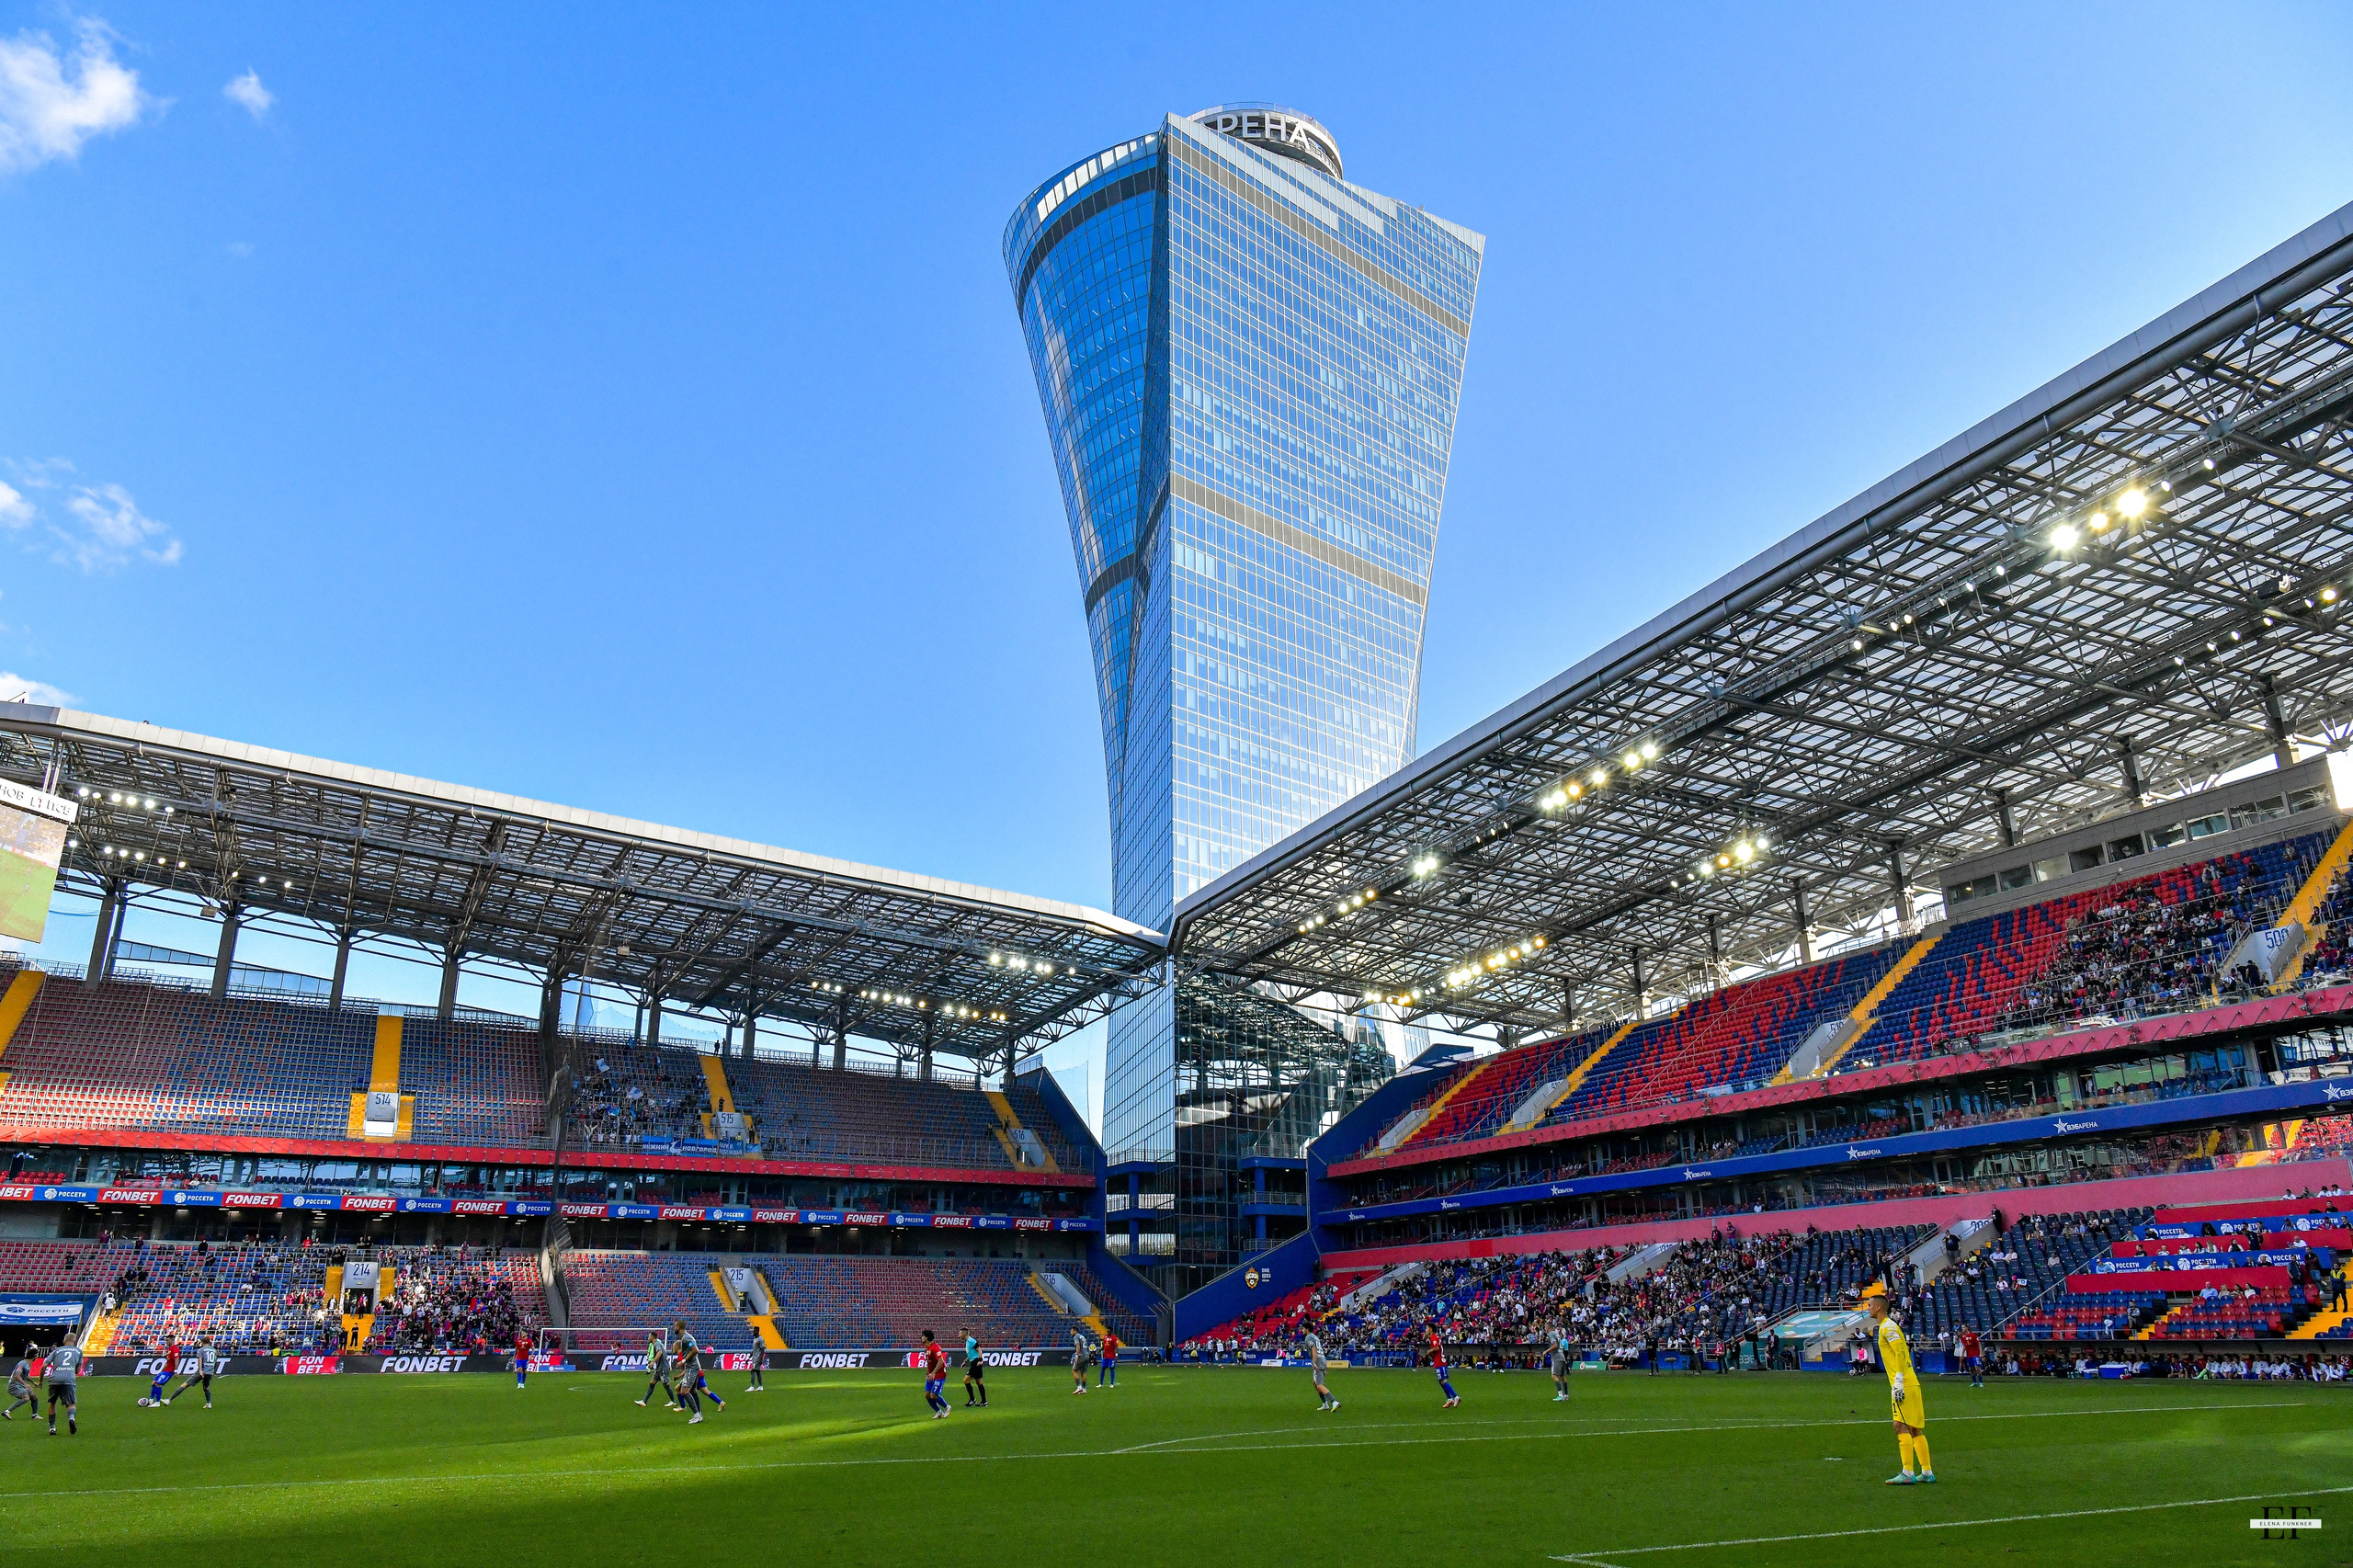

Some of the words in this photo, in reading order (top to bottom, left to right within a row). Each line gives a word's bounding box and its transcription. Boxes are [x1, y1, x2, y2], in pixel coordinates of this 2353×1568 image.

[1200, 112, 1311, 150] РЕНА
[375, 1093, 391, 1105] 514
[722, 1113, 734, 1124] 515
[1014, 1130, 1025, 1140] 516
[102, 1190, 158, 1202] FONBET
[225, 1194, 278, 1206] FONBET
[345, 1198, 395, 1209] FONBET
[455, 1201, 503, 1212] FONBET
[561, 1205, 605, 1215] FONBET
[662, 1208, 705, 1218] FONBET
[756, 1210, 797, 1221] FONBET
[846, 1213, 885, 1223] FONBET
[934, 1216, 972, 1226] FONBET
[1016, 1219, 1051, 1228] FONBET
[353, 1263, 370, 1276] 214
[730, 1268, 744, 1280] 215
[63, 1352, 73, 1366] 2
[206, 1351, 215, 1362] 10
[298, 1356, 324, 1364] FON
[800, 1353, 870, 1368] FONBET
[982, 1352, 1041, 1367] FONBET
[2340, 1356, 2349, 1366] 52
[134, 1358, 232, 1375] FOBT
[296, 1365, 324, 1374] BET
[380, 1356, 467, 1372] FONBET
[733, 1361, 754, 1369] BET
